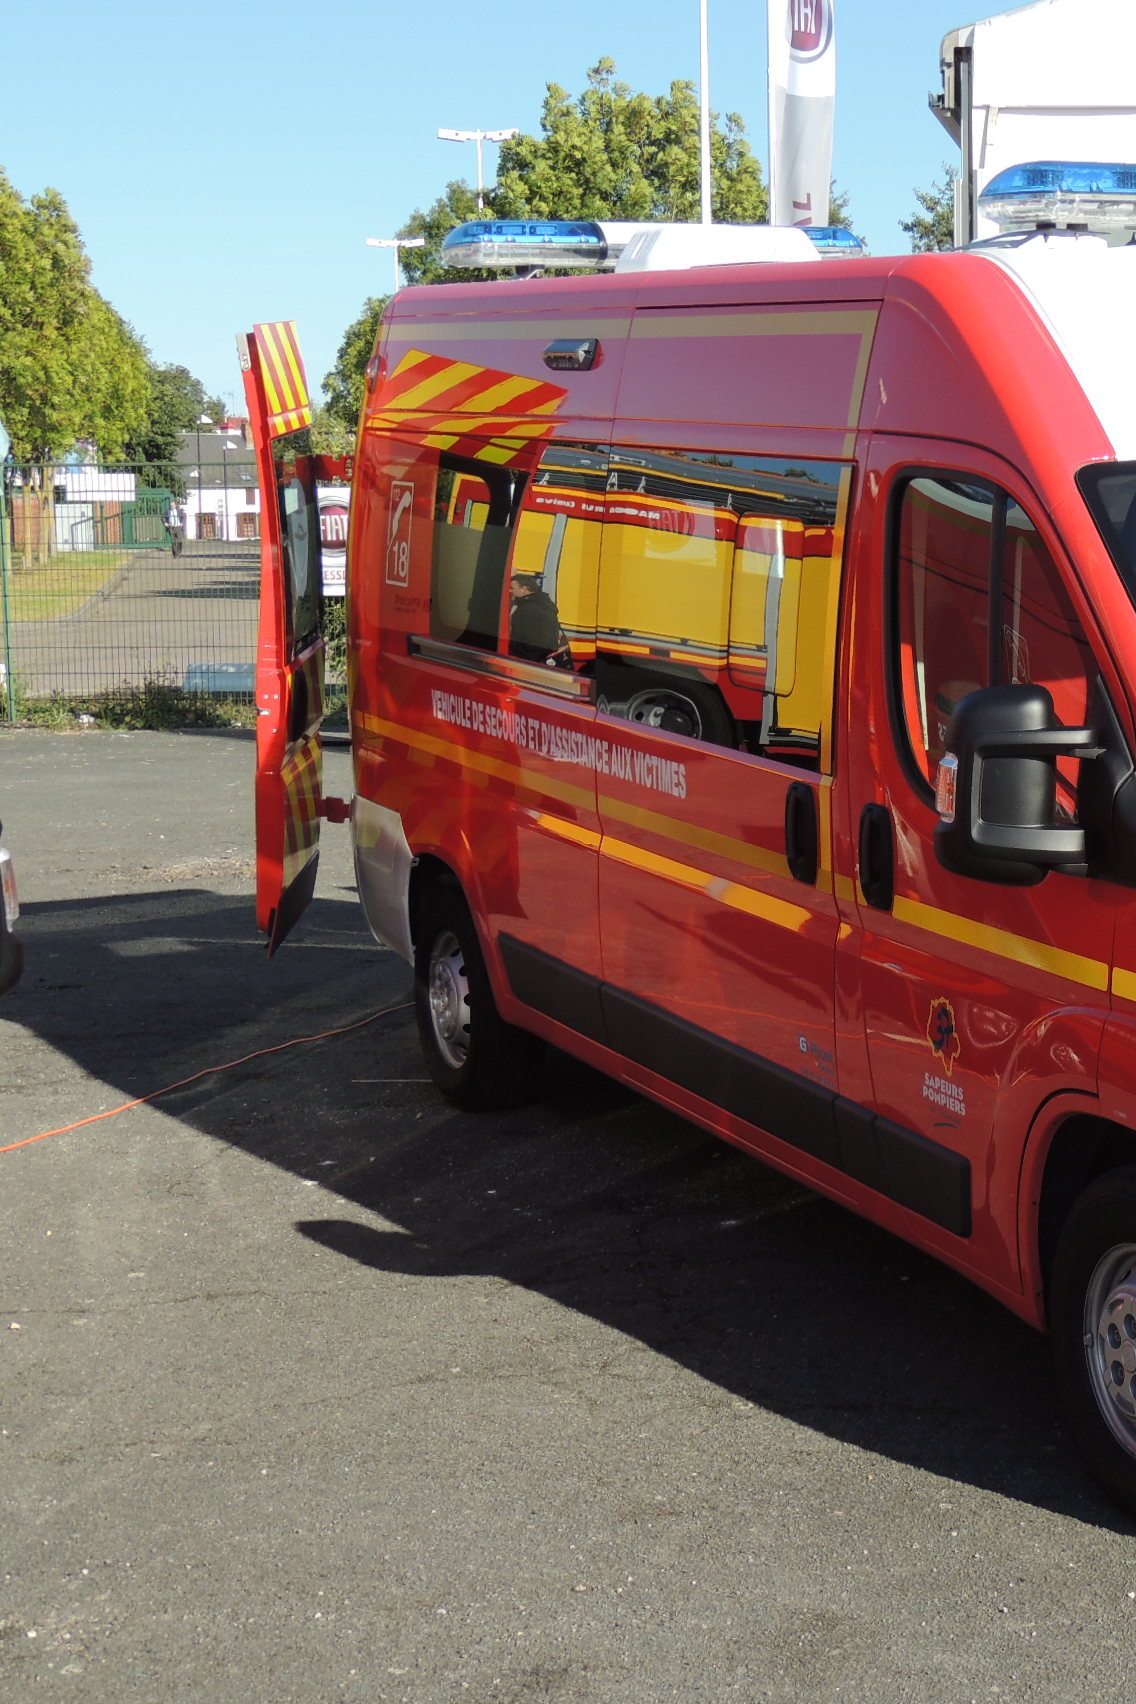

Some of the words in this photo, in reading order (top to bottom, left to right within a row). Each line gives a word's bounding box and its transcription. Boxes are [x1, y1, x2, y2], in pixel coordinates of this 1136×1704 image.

[319, 514, 349, 541] FIAT
[393, 541, 408, 578] 18
[430, 688, 472, 729] VEHICULE
[472, 700, 485, 733] DE
[485, 704, 528, 747] SECOURS
[528, 717, 540, 751] ET
[541, 722, 610, 774] D'ASSISTANCE
[610, 743, 633, 782] AUX
[633, 750, 688, 800] VICTIMES
[922, 1084, 966, 1117] POMPIERS
[924, 1071, 964, 1101] SAPEURS
